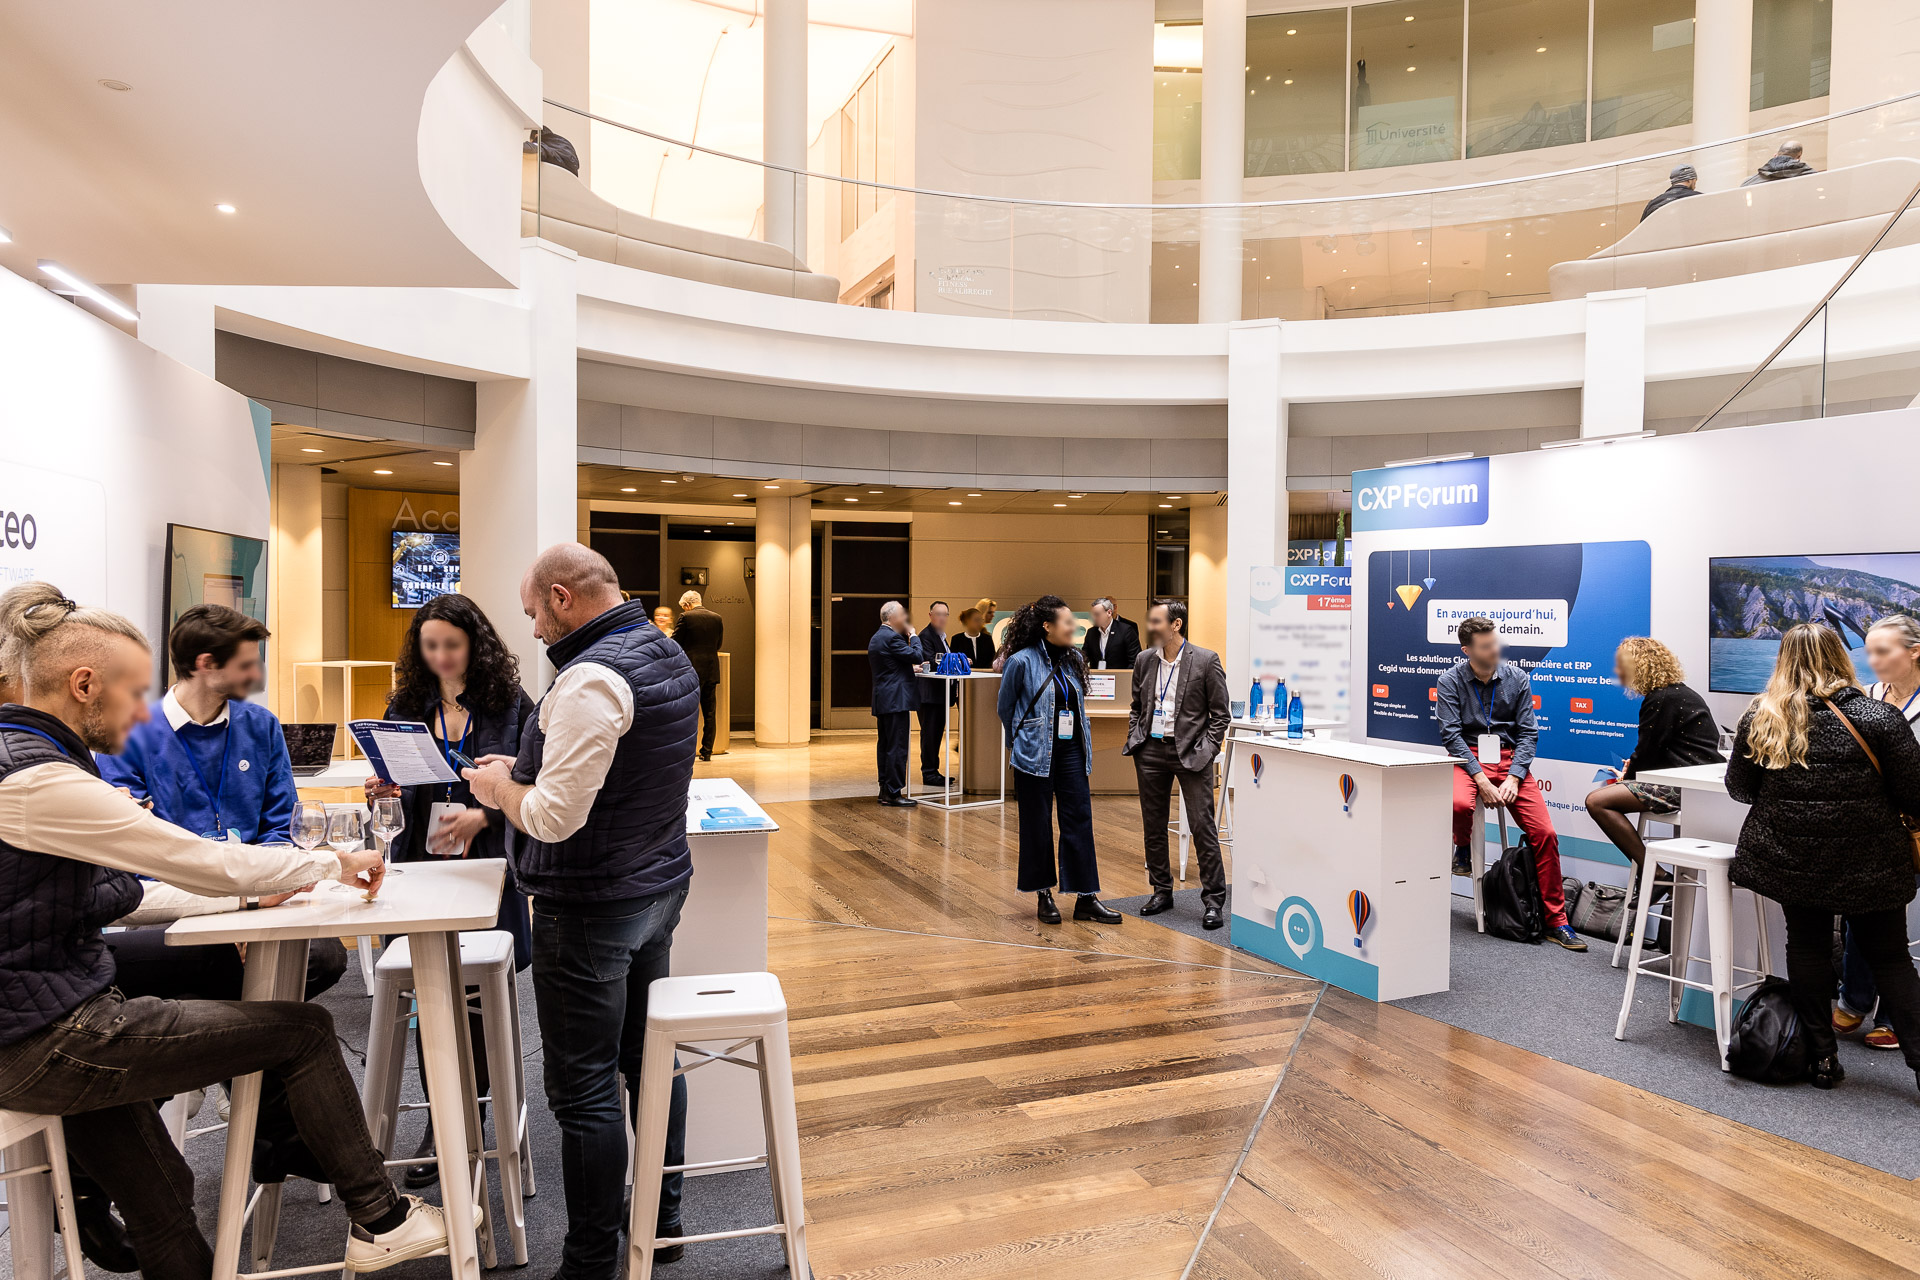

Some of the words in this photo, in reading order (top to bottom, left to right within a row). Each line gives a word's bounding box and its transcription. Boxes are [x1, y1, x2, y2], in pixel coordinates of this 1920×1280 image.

[1380, 123, 1446, 140] Université
[1437, 609, 1448, 618] En
[1451, 610, 1486, 618] avance
[1490, 609, 1556, 622] aujourd'hui,
[1500, 624, 1544, 634] demain.
[1419, 654, 1452, 664] solutions
[1520, 659, 1561, 669] financière
[1575, 662, 1592, 670] ERP
[1378, 664, 1398, 674] Cegid
[1416, 666, 1446, 675] donnent
[1532, 673, 1552, 682] dont
[1577, 676, 1598, 684] avez
